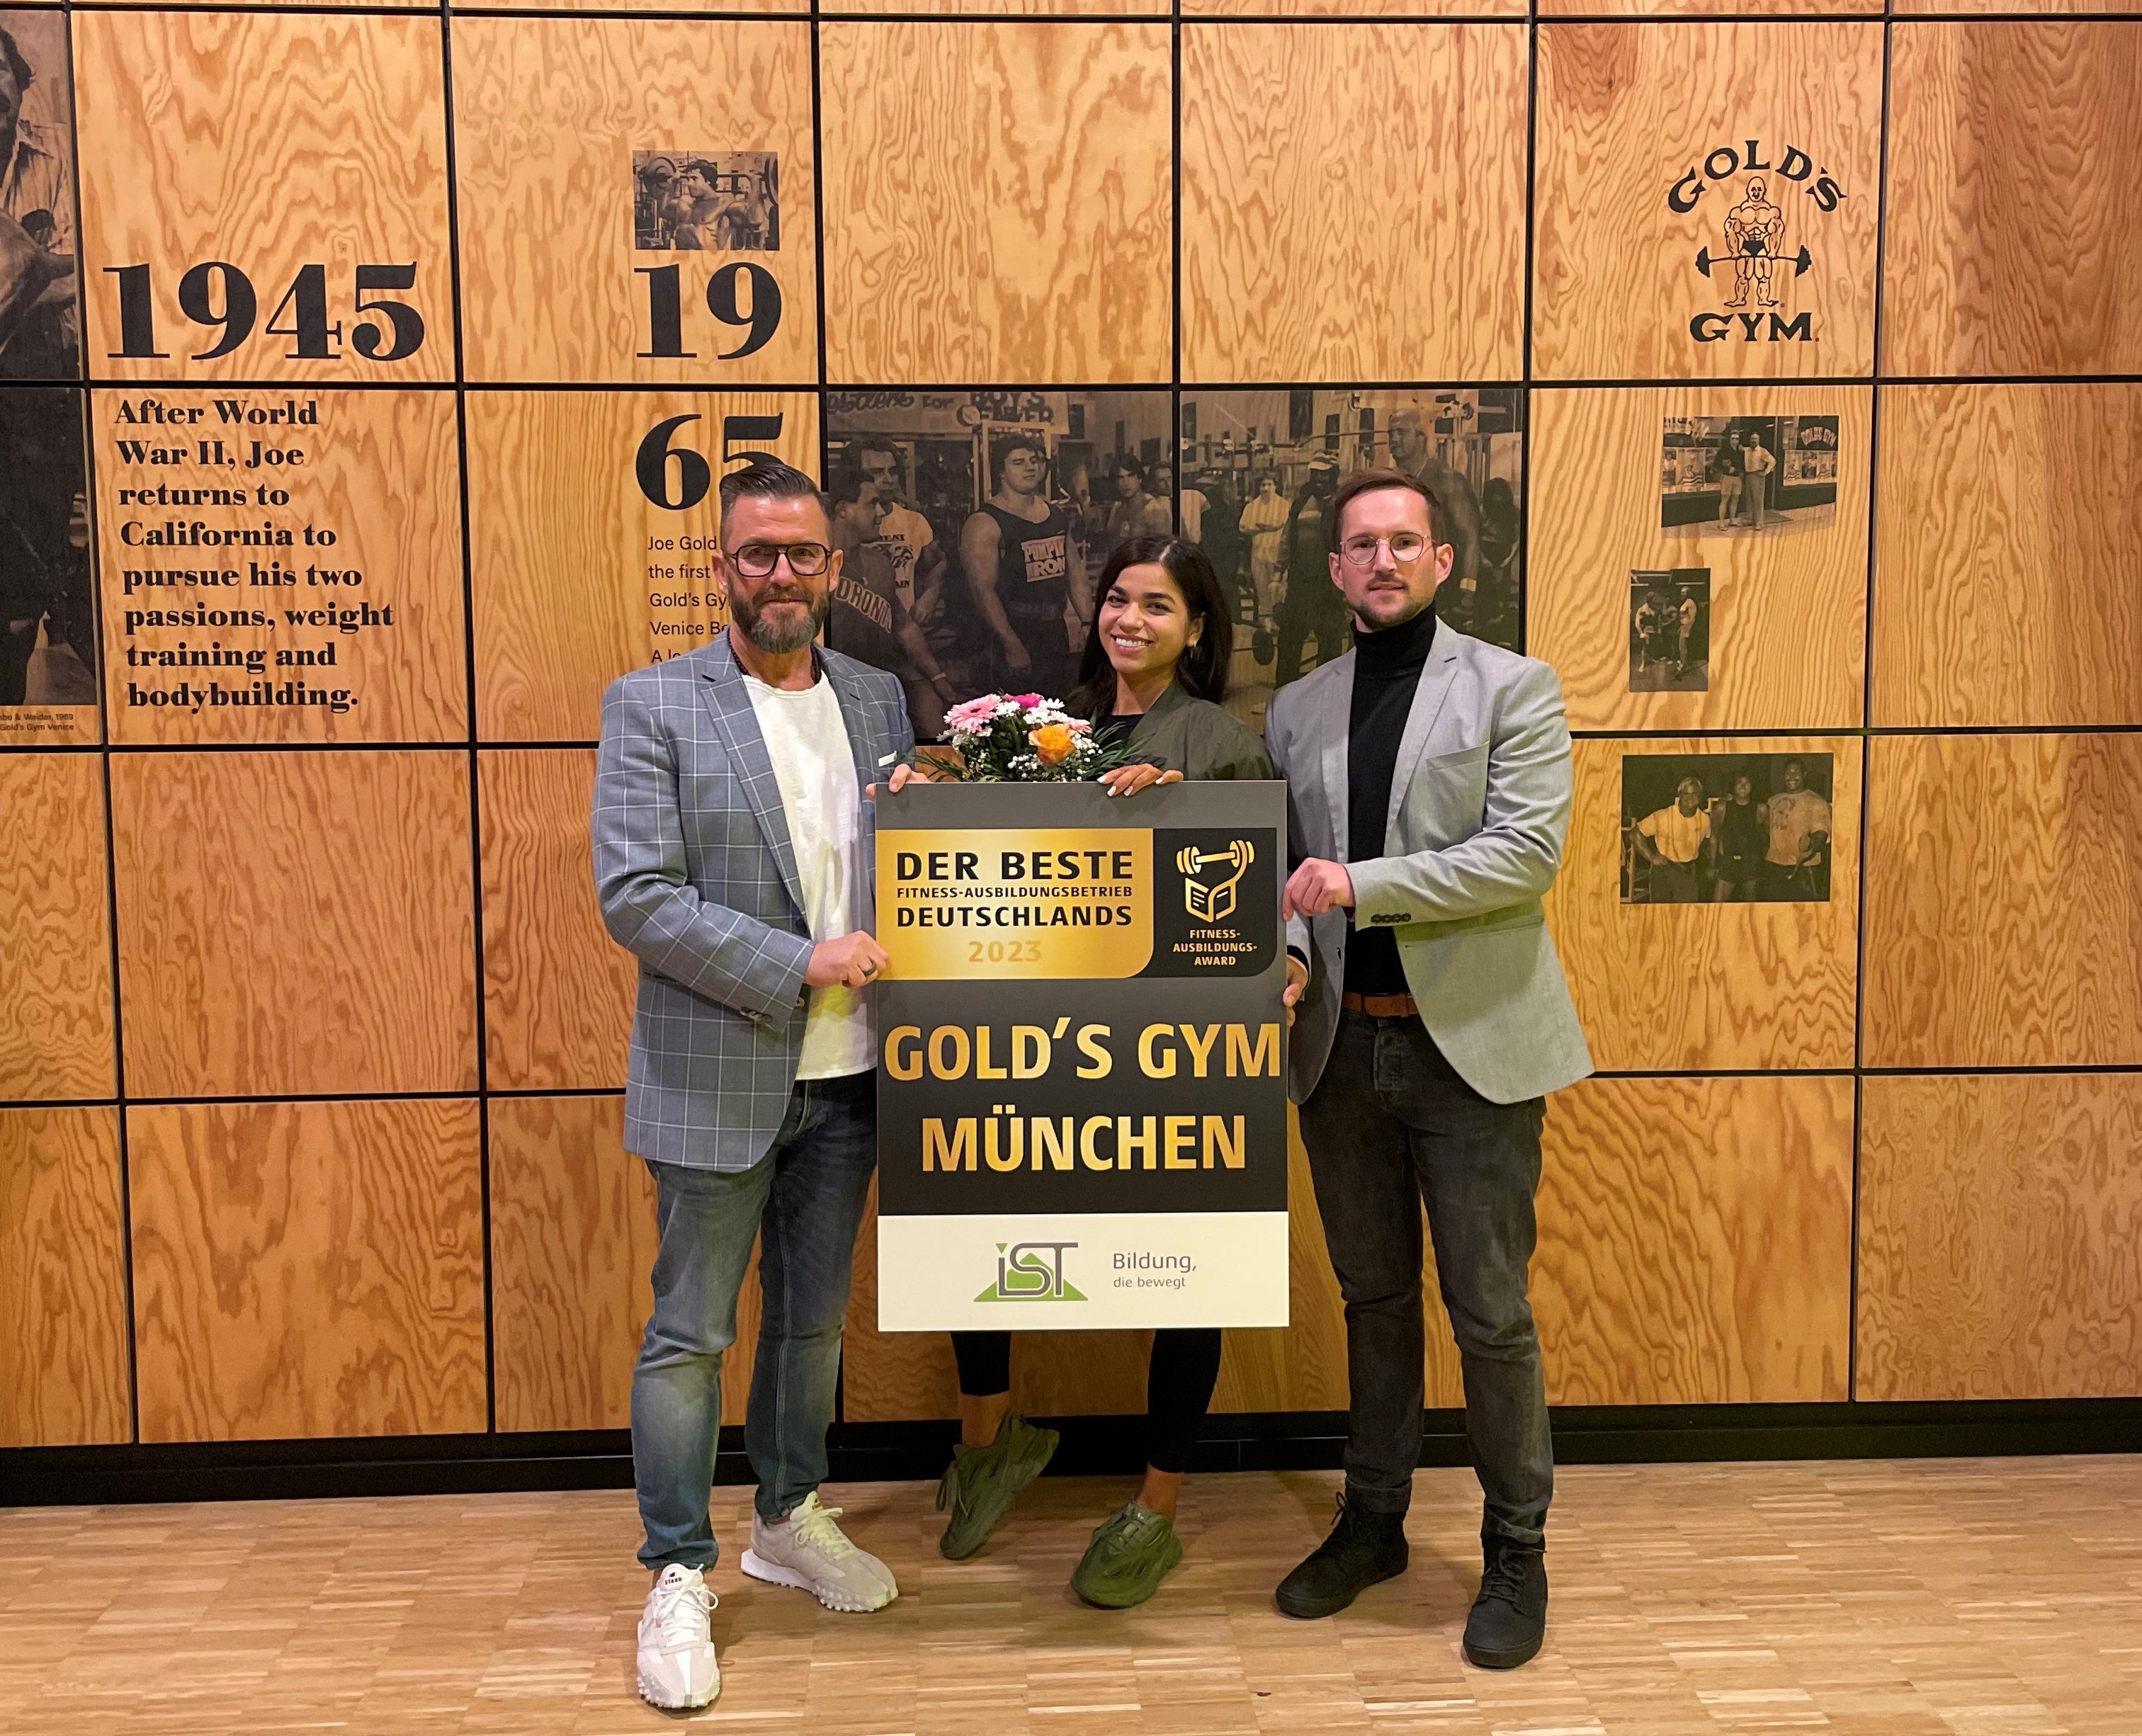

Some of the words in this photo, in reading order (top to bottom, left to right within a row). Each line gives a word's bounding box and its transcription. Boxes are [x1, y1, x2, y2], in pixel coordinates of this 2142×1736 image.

[1667, 140, 1847, 213] GOLD'S
[103, 261, 425, 361] 1945
[634, 262, 782, 359] 19
[1689, 312, 1813, 342] GYM
[114, 399, 205, 425] After
[213, 400, 319, 425] World
[116, 441, 188, 465] War
[198, 441, 236, 470] II,
[245, 441, 305, 468] Joe
[118, 483, 246, 506] returns
[256, 484, 290, 506] to
[121, 521, 293, 546] California
[303, 524, 336, 546] to
[648, 536, 674, 550] Joe
[679, 535, 717, 550] Gold
[123, 567, 239, 594] pursue
[249, 562, 297, 586] his
[306, 565, 362, 586] two
[648, 564, 674, 579] the
[679, 564, 710, 579] first
[1025, 557, 1065, 579] IRON
[650, 592, 700, 608] Gold's
[706, 593, 730, 611] Gy
[125, 602, 276, 635] passions,
[284, 601, 395, 635] weight
[650, 620, 704, 635] Venice
[125, 642, 267, 674] training
[276, 642, 338, 666] and
[651, 649, 663, 663] A
[128, 681, 358, 714] bodybuilding.
[26, 724, 45, 732] Gym
[897, 853, 979, 880] DER
[1001, 851, 1133, 880] BESTE
[897, 886, 1132, 899] FITNESS-AUSBILDUNGSBETRIEB
[897, 906, 1132, 927] DEUTSCHLANDS
[1190, 929, 1241, 939] FITNESS-
[968, 941, 1043, 963] 2023
[1173, 943, 1257, 953] AUSBILDUNGS-
[1194, 956, 1237, 965] AWARD
[884, 1016, 1113, 1081] GOLD'S
[1138, 1023, 1281, 1078] GYM
[922, 1104, 1246, 1171] MÜNCHEN
[1113, 1252, 1197, 1273] Bildung,
[1113, 1276, 1133, 1288] die
[1137, 1276, 1186, 1290] bewegt
